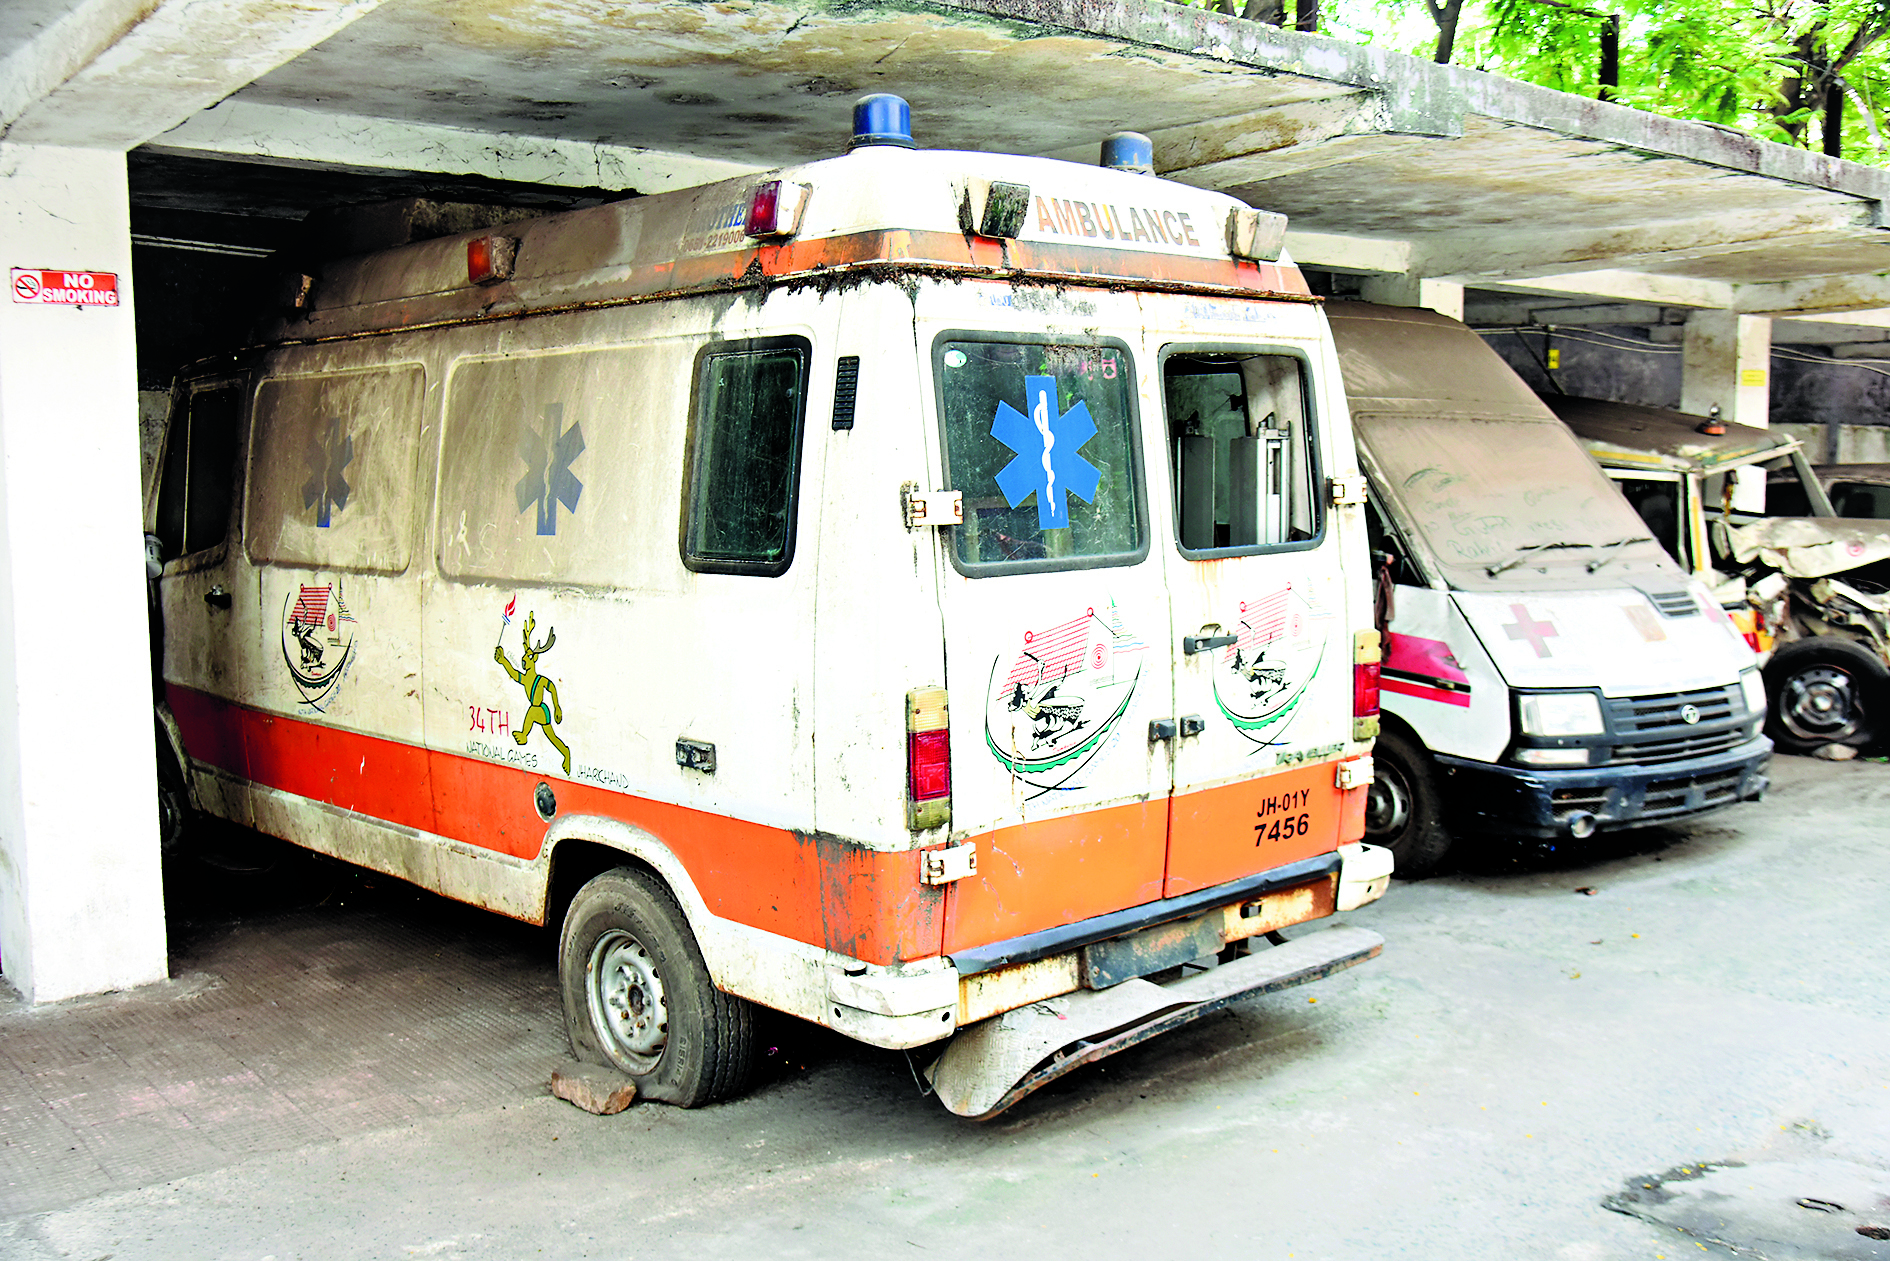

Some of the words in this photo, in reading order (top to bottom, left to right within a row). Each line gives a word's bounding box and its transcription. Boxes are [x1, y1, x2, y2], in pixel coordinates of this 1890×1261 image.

[1034, 195, 1200, 247] AMBULANCE
[63, 273, 94, 288] NO
[43, 288, 116, 304] SMOKING
[468, 706, 510, 737] 34TH
[466, 741, 506, 761] NATIONAL
[1256, 788, 1310, 818] JH-01Y
[1254, 813, 1310, 848] 7456
